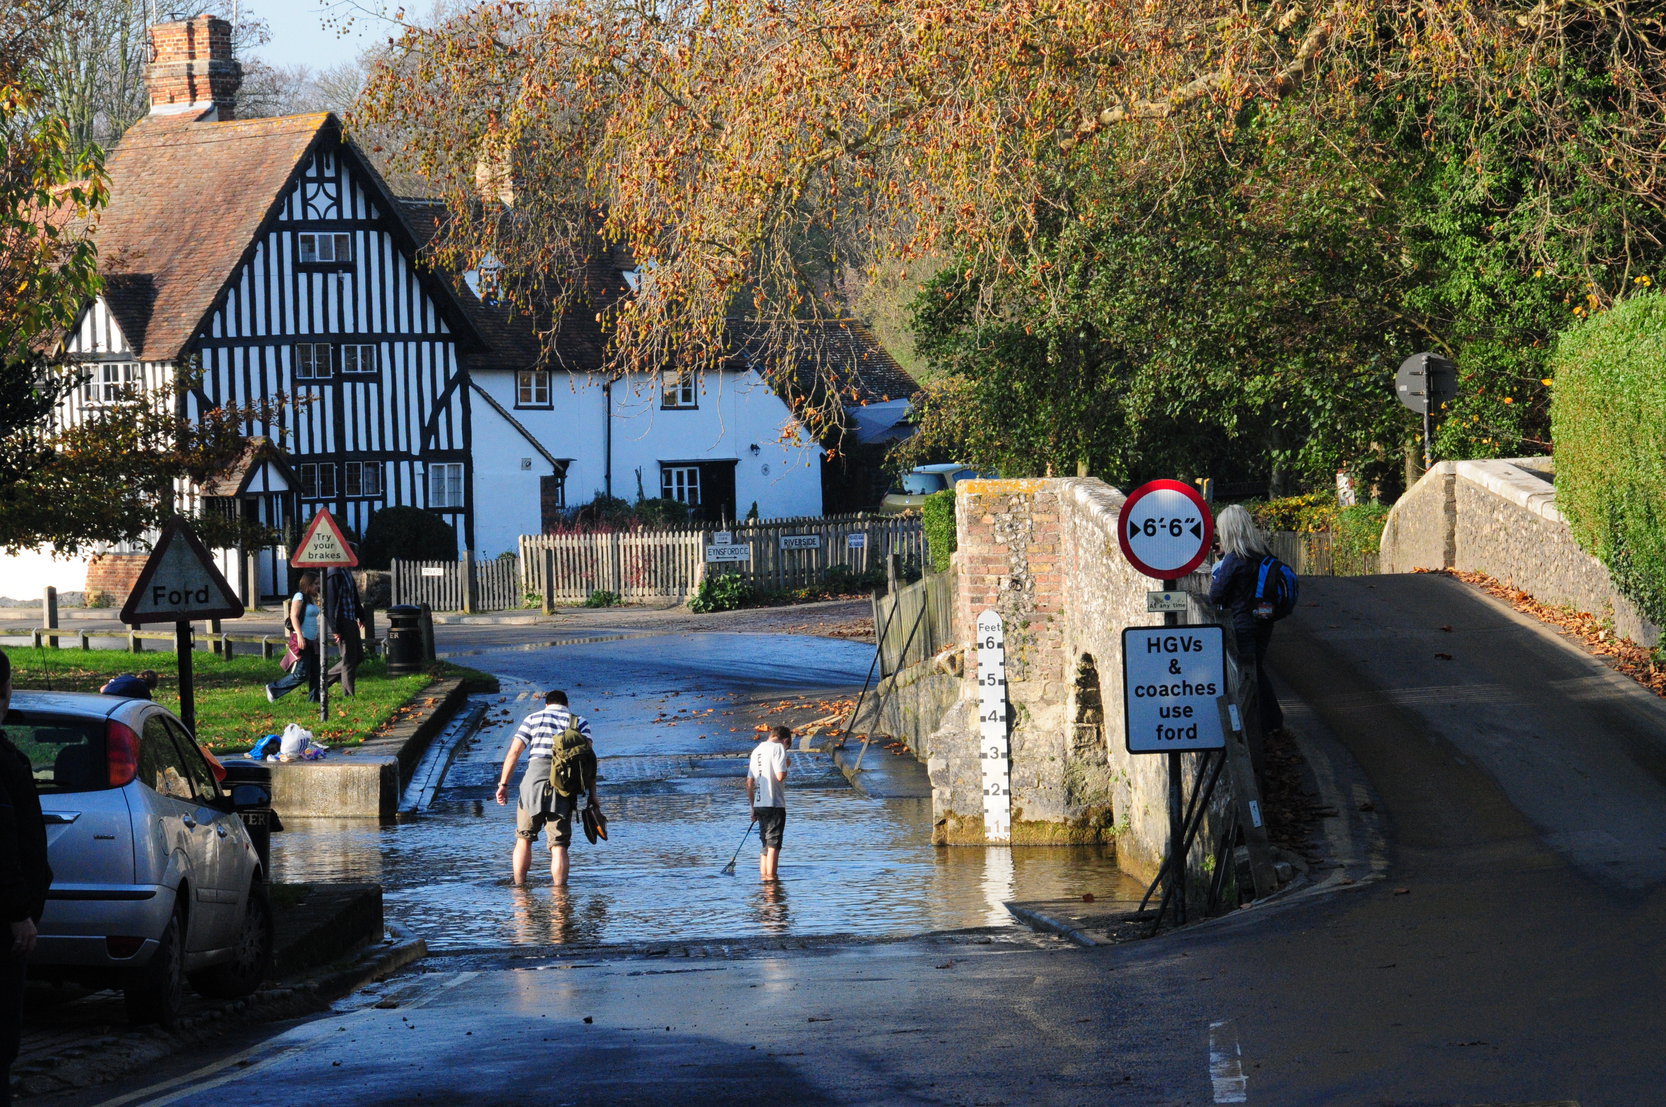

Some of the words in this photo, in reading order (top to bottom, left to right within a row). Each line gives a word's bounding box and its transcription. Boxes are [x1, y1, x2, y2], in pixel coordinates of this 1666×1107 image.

[316, 533, 331, 542] Try
[784, 538, 816, 546] RIVERSIDE
[708, 548, 739, 556] EYNSFORD
[153, 585, 208, 605] Ford
[978, 623, 1001, 632] Feet
[985, 637, 995, 649] 6
[1147, 636, 1203, 653] HGVs
[1169, 658, 1181, 674] &
[987, 673, 996, 686] 5
[1135, 680, 1217, 697] coaches
[987, 710, 998, 723] 4
[1160, 705, 1193, 718] use
[1156, 723, 1197, 740] ford
[990, 747, 999, 760] 3
[991, 783, 1001, 796] 2
[239, 813, 266, 825] TER
